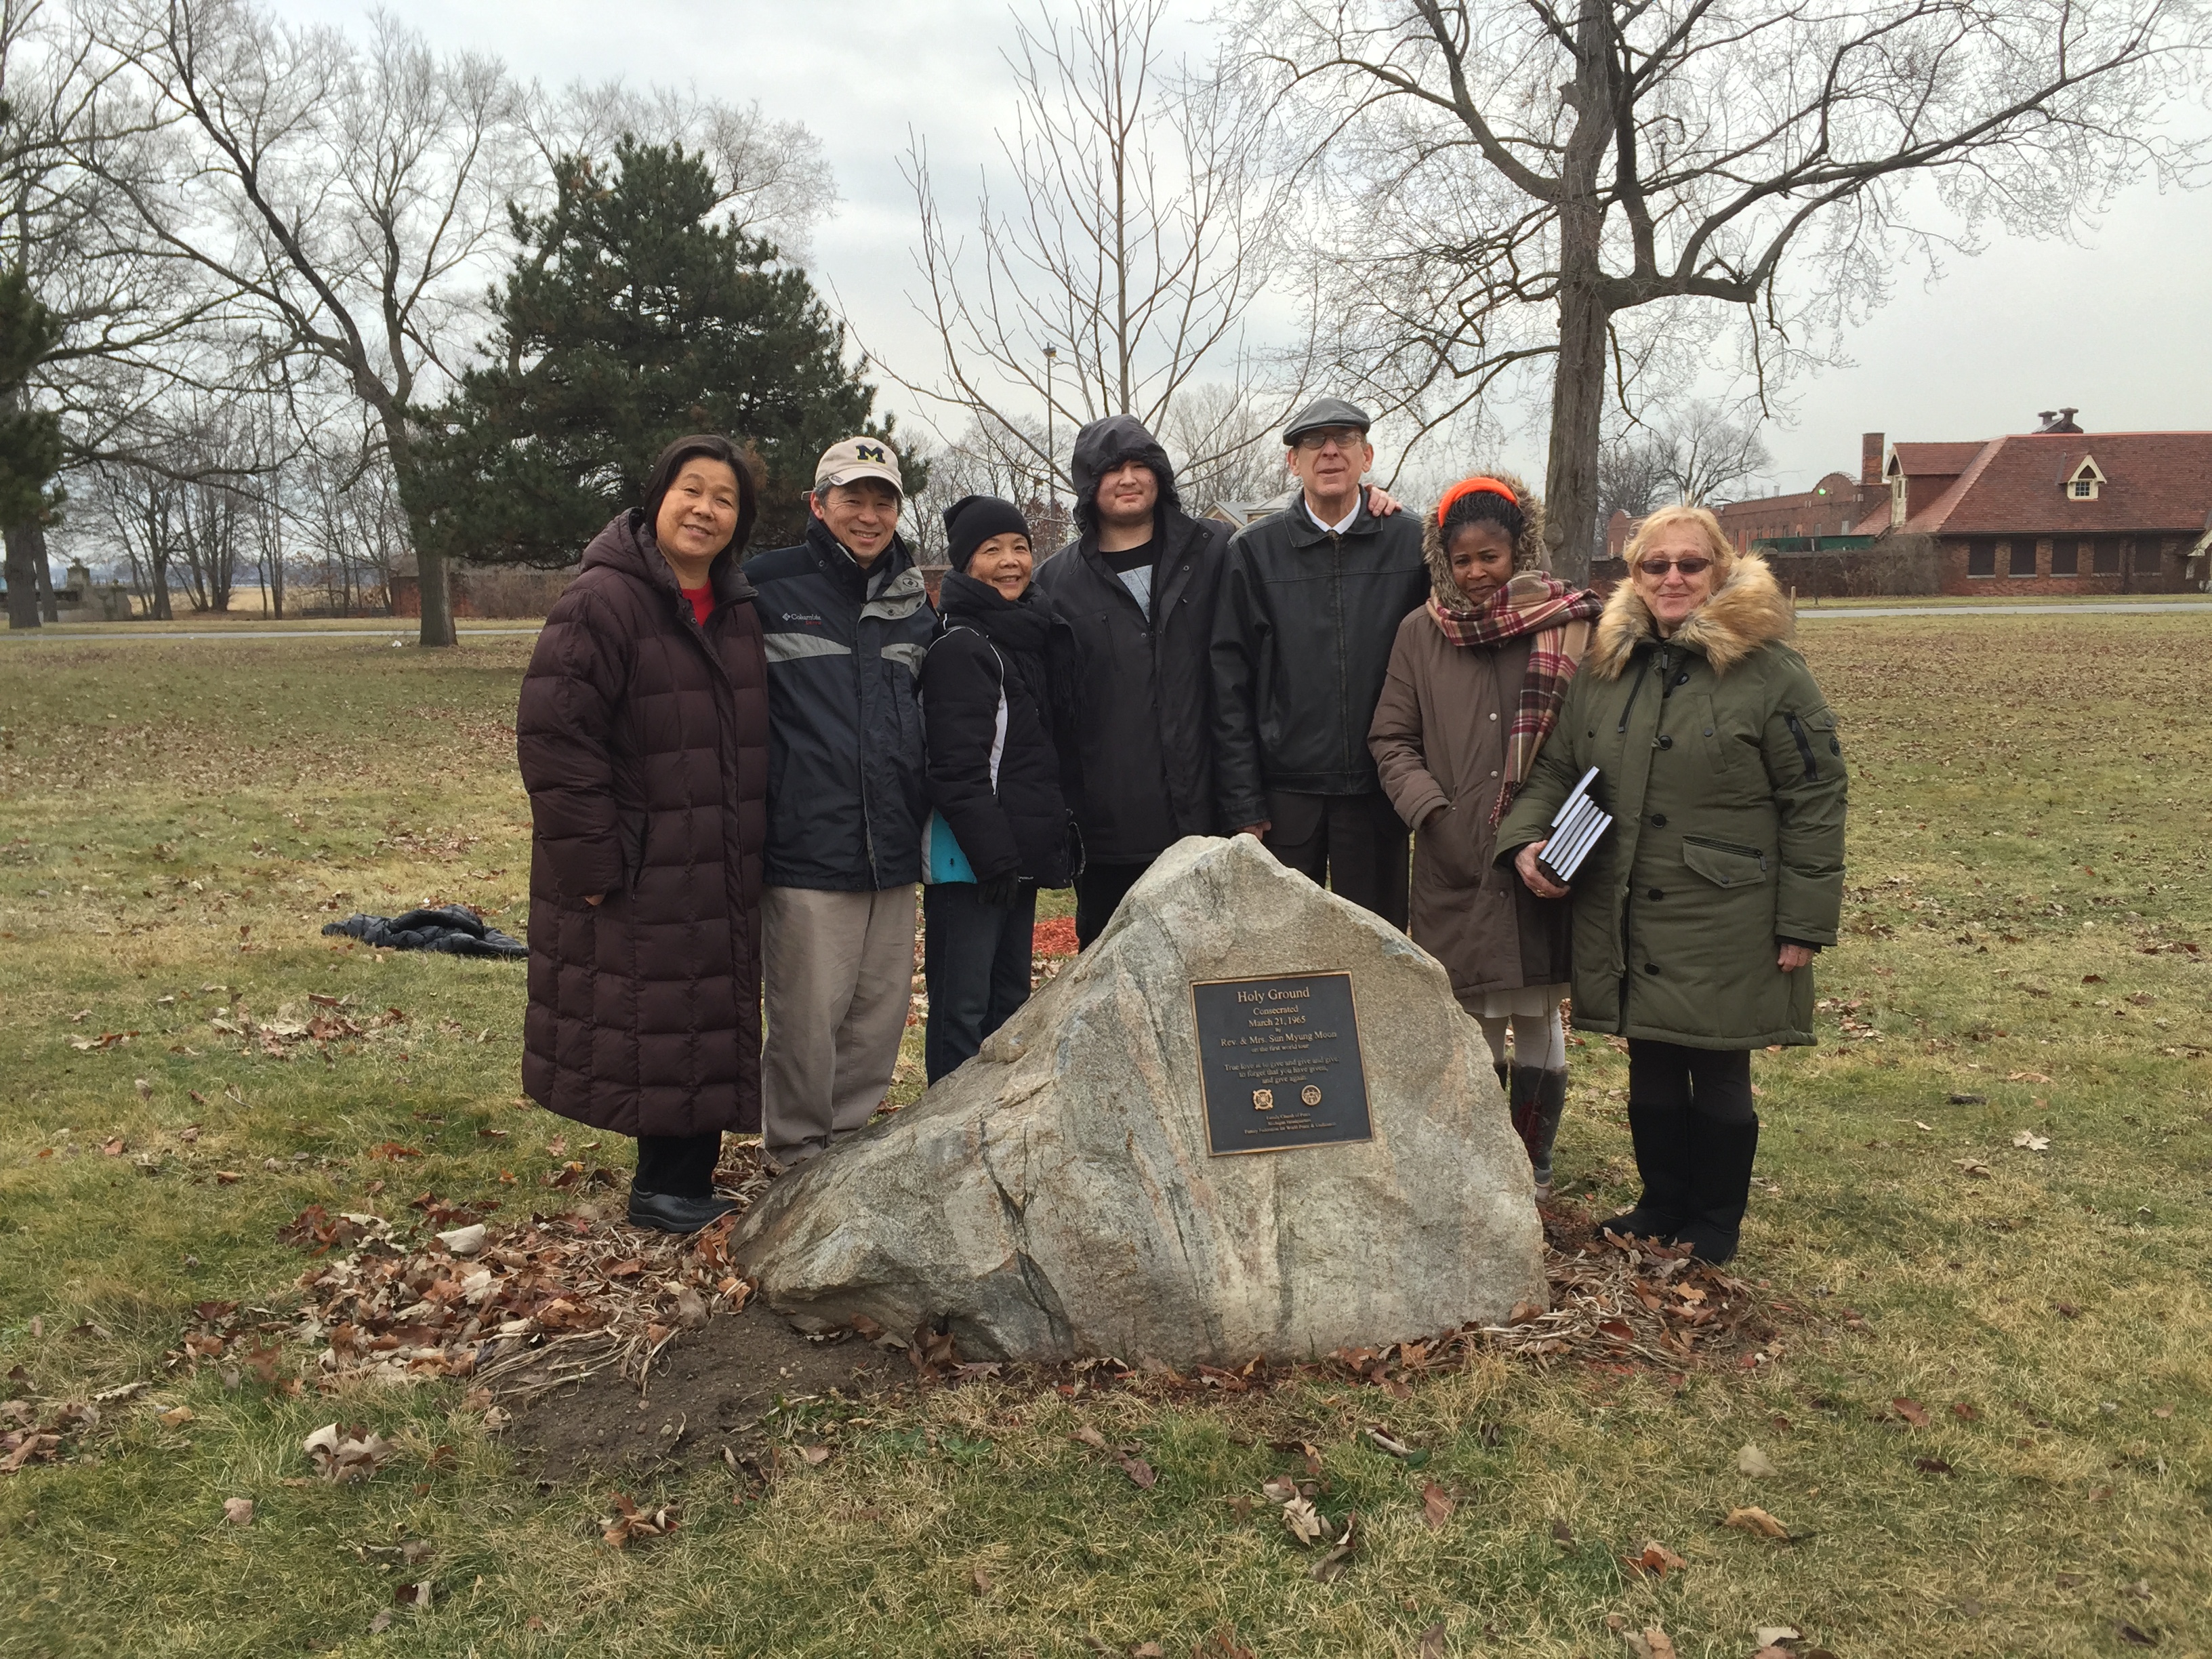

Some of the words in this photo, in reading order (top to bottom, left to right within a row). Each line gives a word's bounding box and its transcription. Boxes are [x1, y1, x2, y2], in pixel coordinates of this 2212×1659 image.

[855, 445, 887, 465] M
[1237, 990, 1265, 1004] Holy
[1268, 987, 1310, 1000] Ground
[1253, 1004, 1298, 1015] Consecrated
[1248, 1018, 1273, 1027] March
[1275, 1017, 1286, 1025] 21,
[1288, 1016, 1306, 1025] 1965
[1221, 1038, 1237, 1046] Rev.
[1240, 1037, 1247, 1045] &
[1249, 1036, 1267, 1044] Mrs.
[1269, 1034, 1284, 1042] Sun
[1285, 1033, 1313, 1042] Myung
[1314, 1031, 1337, 1040] Moon
[1297, 1059, 1311, 1067] give
[1247, 1069, 1266, 1078] forget
[1280, 1068, 1292, 1076] you
[1262, 1076, 1273, 1084] and
